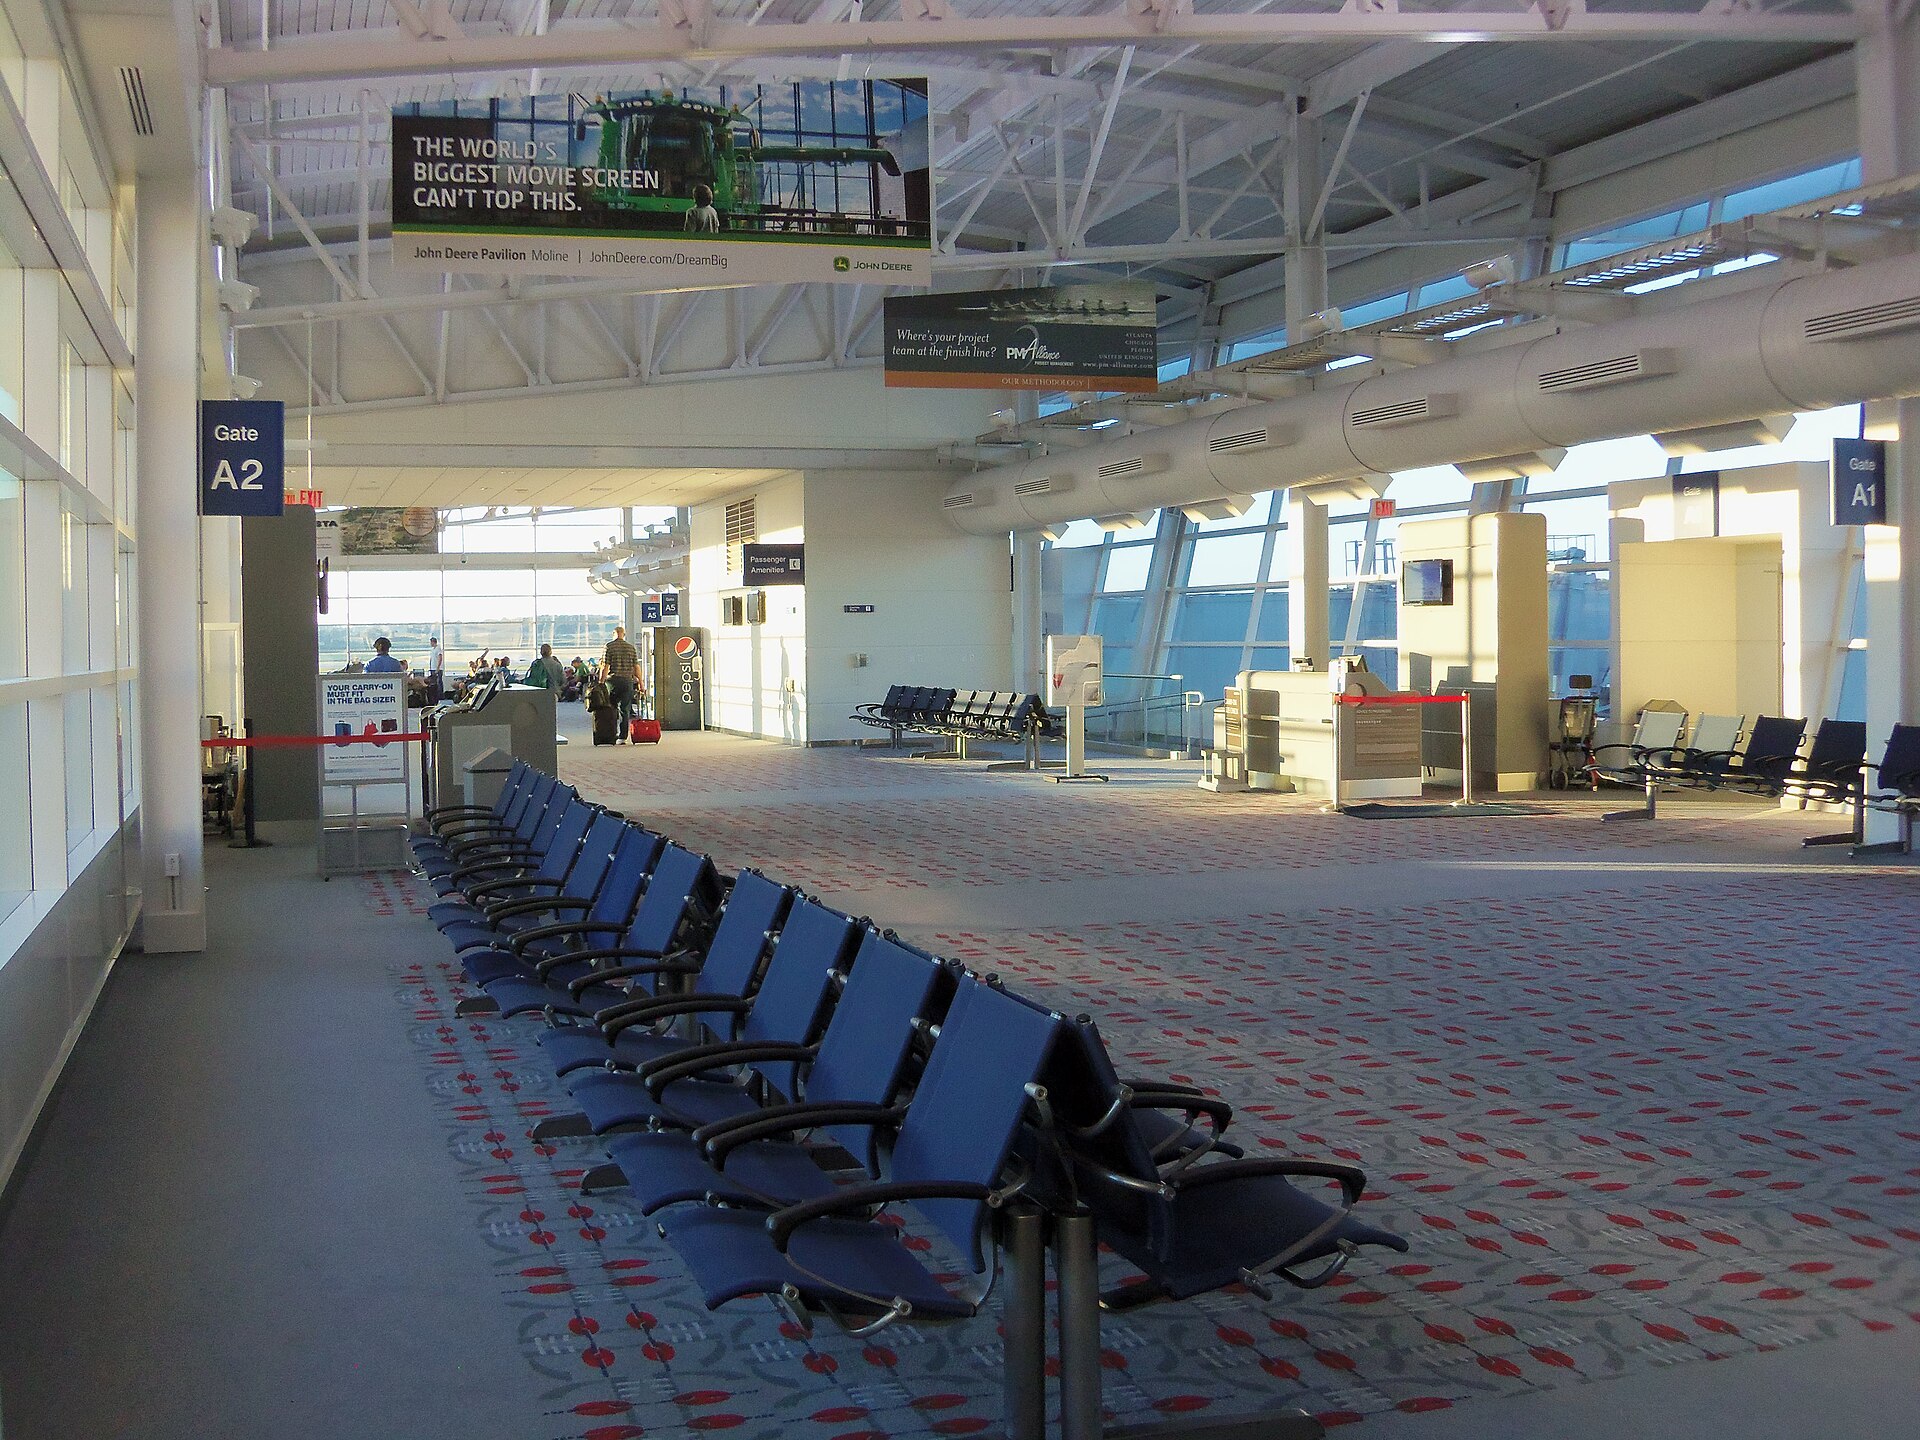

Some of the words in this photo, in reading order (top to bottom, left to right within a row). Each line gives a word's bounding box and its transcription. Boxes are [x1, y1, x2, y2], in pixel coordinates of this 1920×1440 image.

[412, 136, 455, 158] THE
[460, 138, 558, 161] WORLD'S
[413, 162, 501, 184] BIGGEST
[507, 165, 577, 187] MOVIE
[582, 167, 660, 190] SCREEN
[413, 187, 478, 209] CAN'T
[483, 189, 525, 210] TOP
[530, 190, 583, 212] THIS.
[414, 247, 442, 259] John
[445, 248, 479, 260] Deere
[481, 248, 527, 261] Pavilion
[531, 249, 569, 262] Moline
[589, 251, 728, 269] JohnDeere.com/DreamBig
[853, 261, 880, 270] JOHN
[881, 262, 913, 271] DEERE
[897, 328, 933, 341] Where's
[931, 334, 957, 345] your
[958, 333, 990, 346] project
[892, 345, 915, 355] team
[917, 346, 927, 356] at
[929, 345, 943, 356] the
[944, 345, 971, 360] finish
[973, 346, 997, 358] line?
[1001, 377, 1020, 385] OUR
[1021, 378, 1084, 387] METHODOLOGY
[214, 424, 259, 441] Gate
[1849, 457, 1876, 471] Gate
[211, 459, 264, 490] A2
[300, 490, 323, 508] EXIT
[1850, 482, 1876, 507] A1
[1376, 501, 1393, 516] EXIT
[750, 556, 786, 564] Passenger
[352, 683, 394, 691] CARRY-ON
[679, 662, 694, 704] pepsi
[372, 696, 396, 704] SIZER
